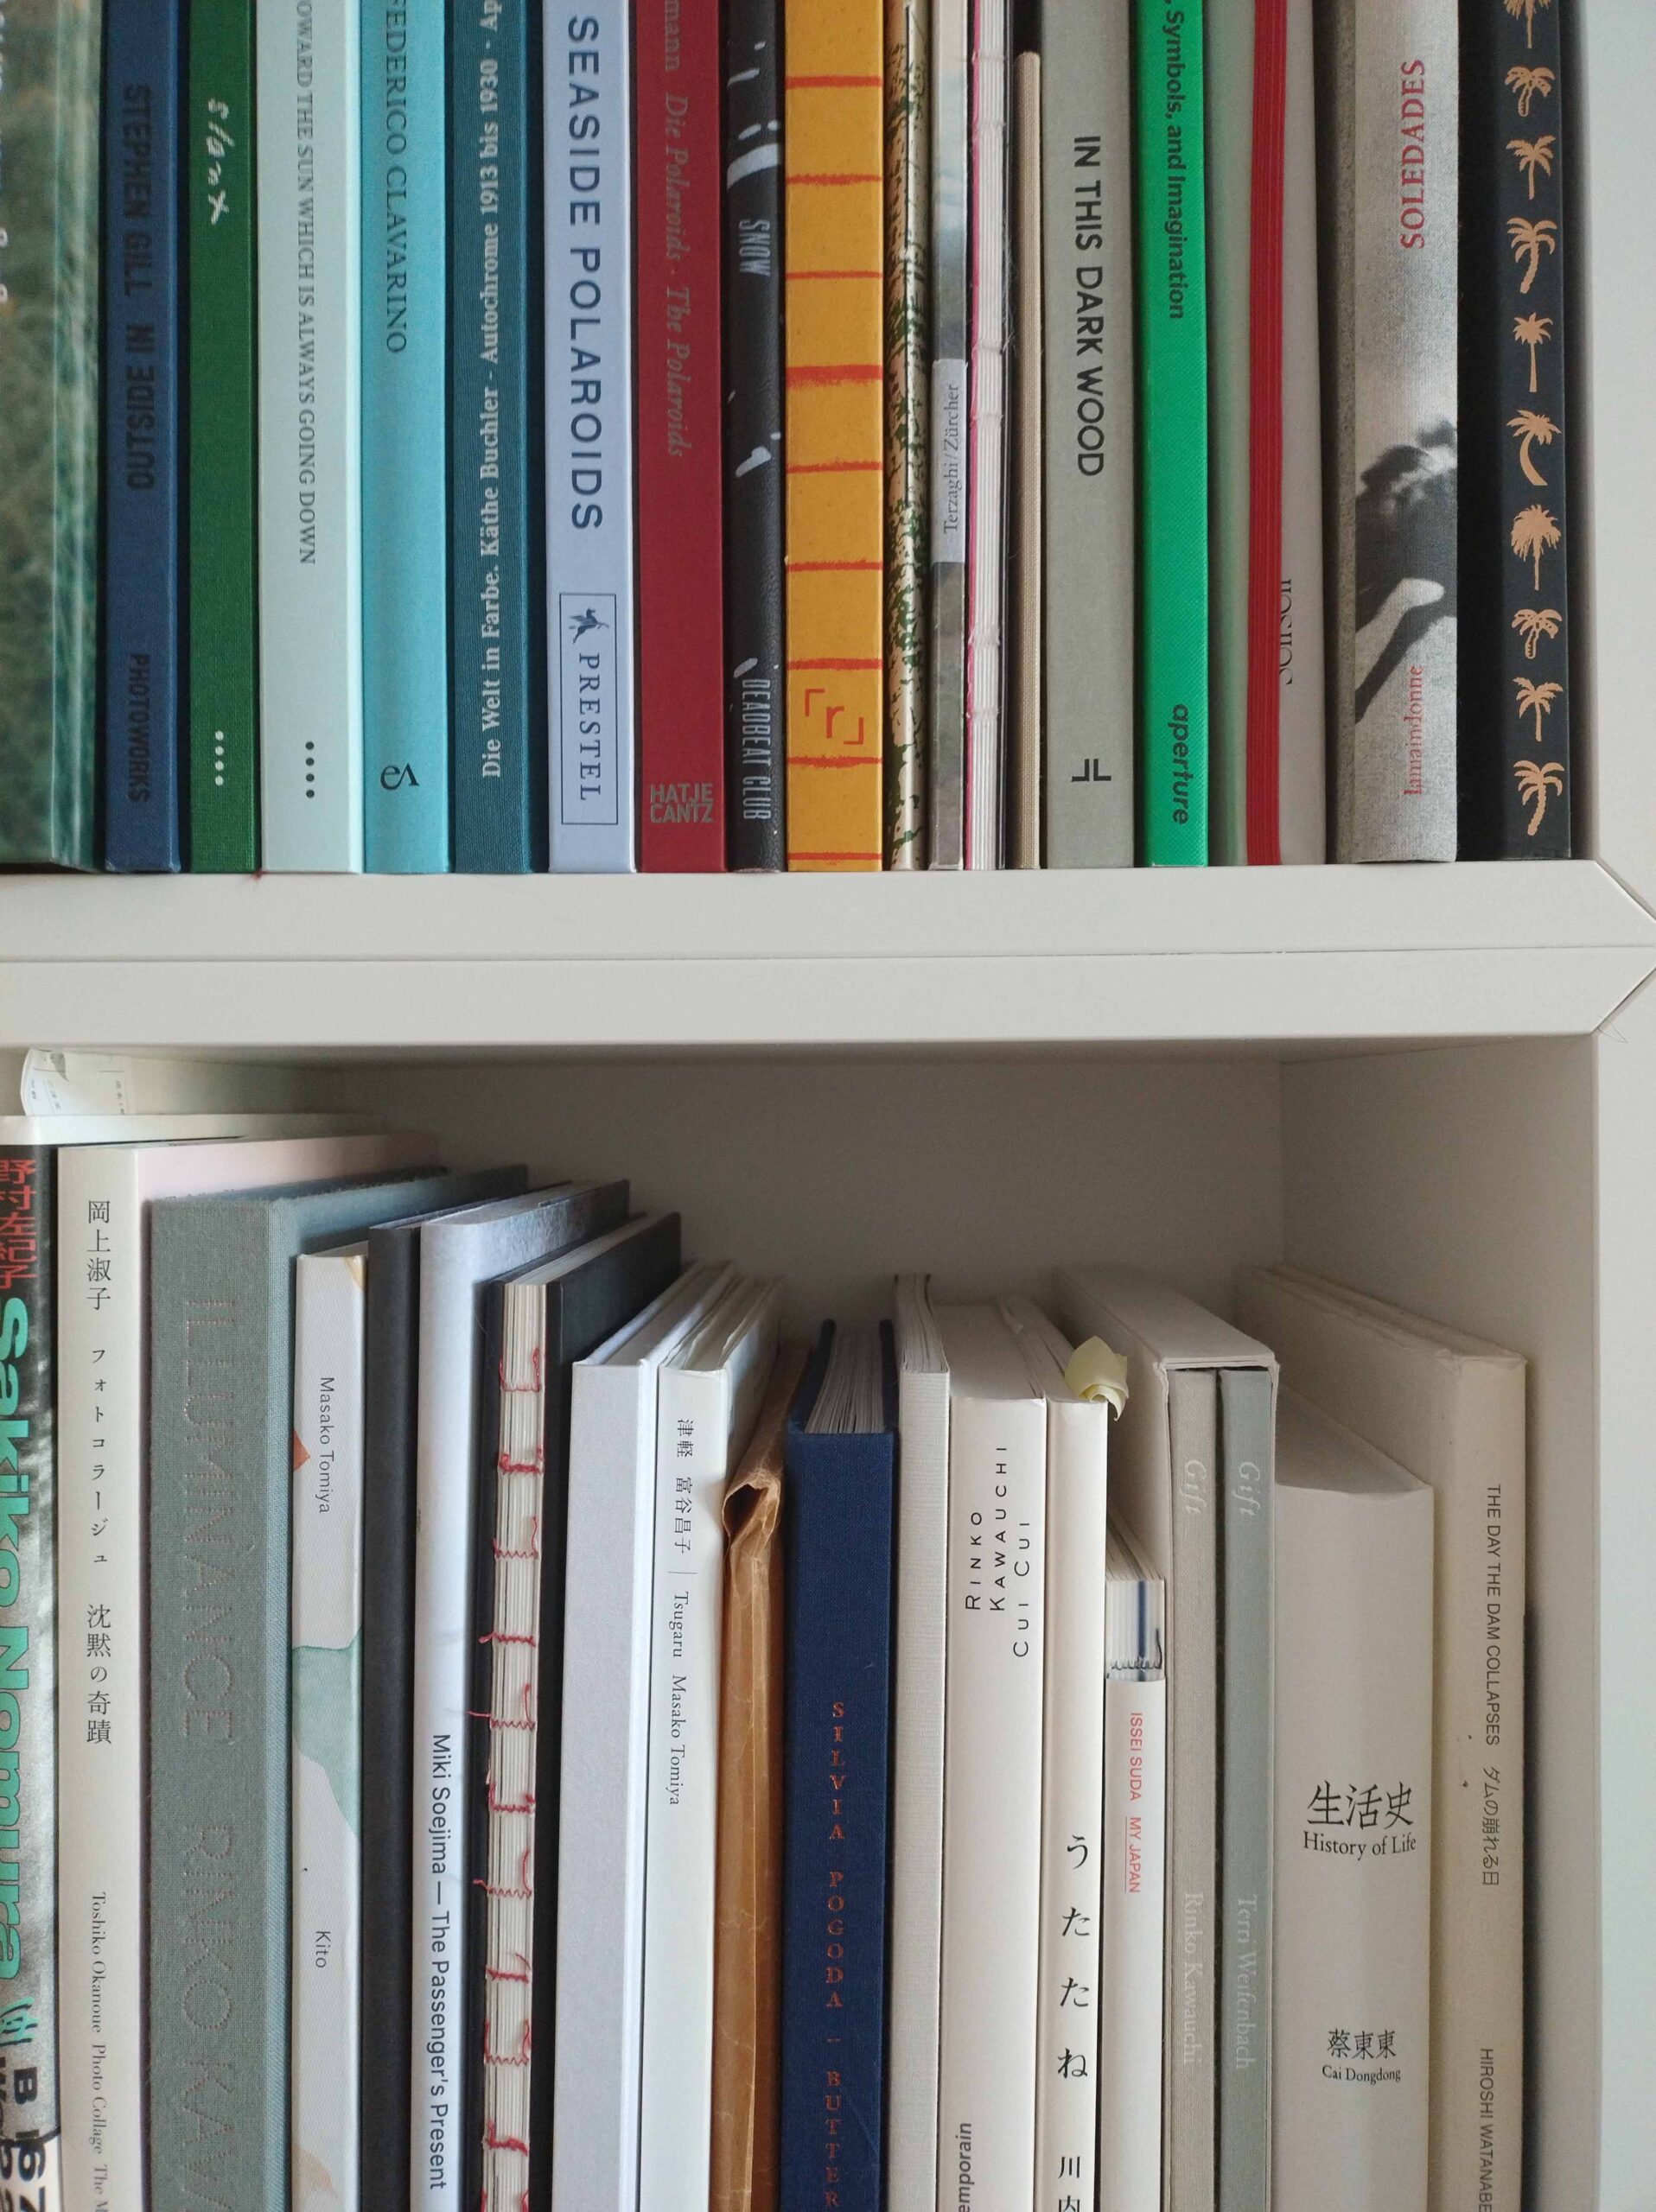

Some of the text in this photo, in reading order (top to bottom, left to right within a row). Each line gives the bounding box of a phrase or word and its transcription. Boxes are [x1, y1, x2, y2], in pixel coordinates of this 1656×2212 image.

[297, 94, 313, 140] THE
[480, 60, 498, 112] 1930
[665, 92, 688, 137] Die
[297, 145, 313, 191] SUN
[480, 123, 498, 158] bis
[1166, 125, 1186, 169] and
[1399, 59, 1425, 250] SOLEDADES
[123, 84, 153, 296] STEPHEN GILL
[481, 165, 498, 213] 1913
[666, 143, 691, 261] Polaroids
[298, 197, 314, 279] WHICH
[386, 166, 406, 353] CLAVARINO
[569, 16, 603, 529] SEASIDE POLAROIDS
[742, 220, 770, 277] SNOW
[1167, 176, 1188, 319] Imagination
[299, 286, 314, 307] IS
[480, 224, 498, 364] Autochrome
[666, 286, 691, 333] The
[1074, 136, 1105, 477] IN THIS DARK WOOD
[299, 312, 315, 404] ALWAYS
[480, 386, 499, 479] Buchler
[666, 339, 692, 457] Polaroids
[299, 409, 315, 484] GOING
[300, 492, 315, 563] DOWN
[481, 487, 499, 556] Käthe
[481, 565, 500, 638] Farbe.
[481, 647, 500, 671] in
[482, 679, 500, 731] Welt
[579, 654, 601, 800] PRESTEL
[1403, 664, 1424, 795] lamaindonne
[482, 740, 500, 777] Die
[742, 679, 771, 820] DEADBEAT CLUB
[1169, 704, 1194, 825] aperture
[650, 783, 714, 803] HATJE
[650, 803, 714, 823] CANTZ
[87, 1201, 111, 1310] 岡上淑子
[315, 1377, 334, 1512] Masako Tomiya
[674, 1419, 694, 1554] 津軽 富谷昌子
[965, 1511, 983, 1611] RINKO
[990, 1447, 1007, 1611] KAWAUCHI
[1013, 1522, 1029, 1657] CUI CUI
[1487, 1485, 1500, 1745] THE DAY THE DAM COLLAPSES
[666, 1592, 689, 1805] Tsugaru Masako Tomiya
[1129, 1712, 1143, 1893] ISSEI SUDA MY JAPAN
[1308, 1780, 1413, 1829] 生活史
[1482, 1767, 1500, 1885] ダムの崩れる日
[1303, 1831, 1416, 1860] History of Life
[92, 1892, 106, 1955] Toshiko
[315, 1931, 331, 1967] Kito
[824, 1701, 846, 2206] SILVIA POGODA BUTTER
[1058, 1834, 1090, 2079] うたたね
[92, 1961, 105, 2032] Okanoue
[429, 1735, 451, 2190] Miki Soejima The Passenger's Present
[92, 2045, 105, 2090] Photo
[1322, 2065, 1400, 2085] Cai Dongdong
[1327, 2028, 1396, 2060] 蔡東東
[1480, 2048, 1494, 2119] HIROSHI
[89, 2097, 107, 2154] Collage
[94, 2167, 107, 2195] The
